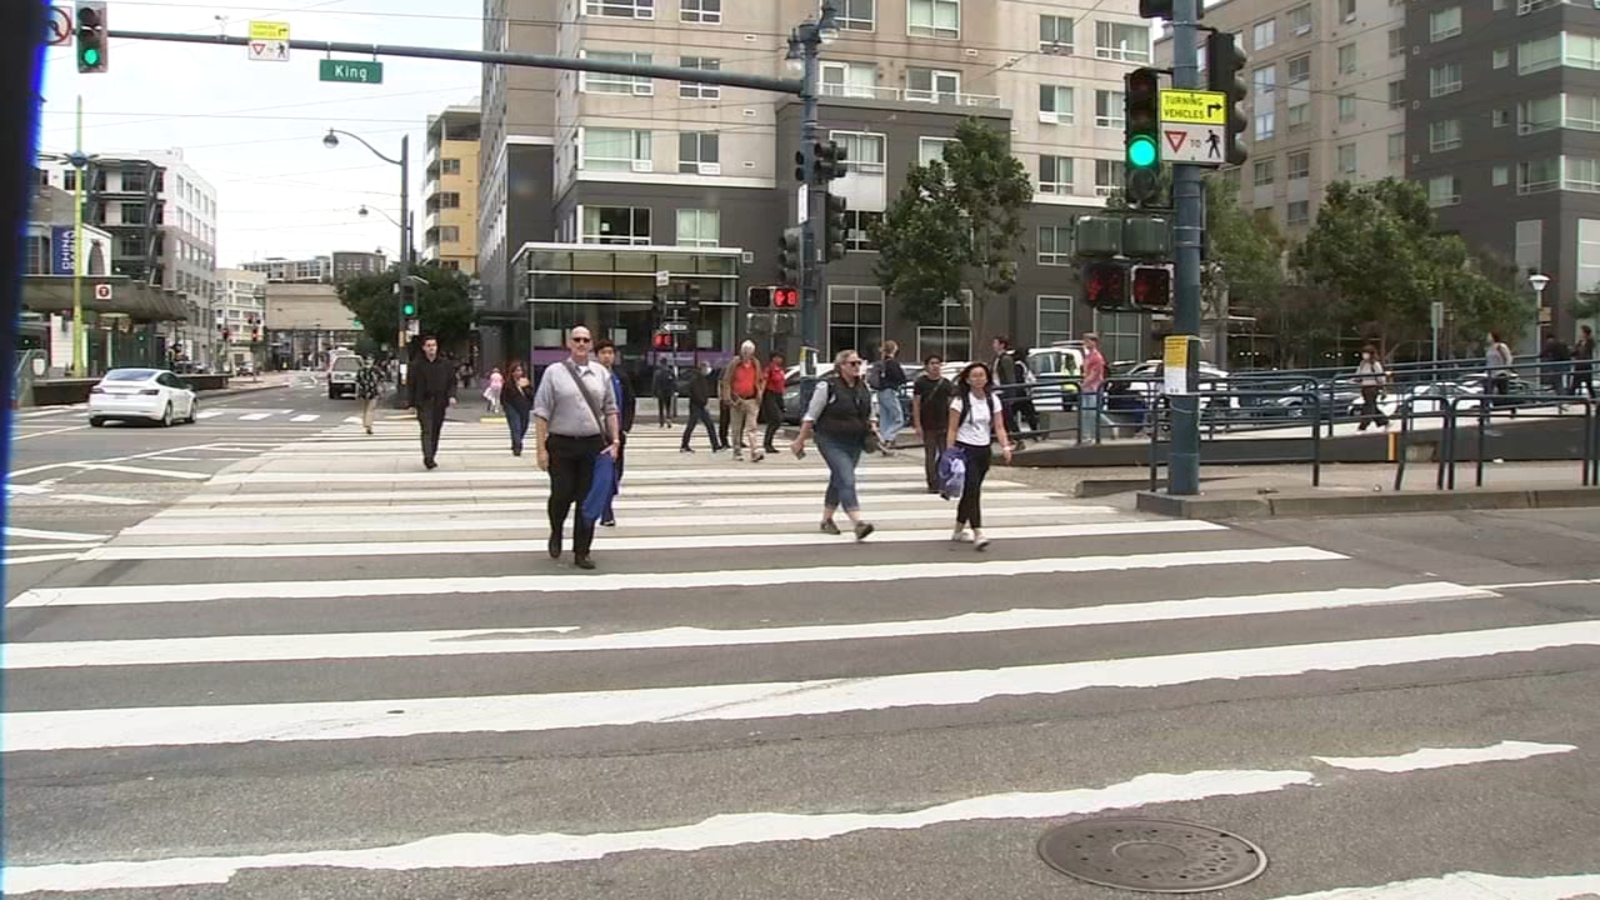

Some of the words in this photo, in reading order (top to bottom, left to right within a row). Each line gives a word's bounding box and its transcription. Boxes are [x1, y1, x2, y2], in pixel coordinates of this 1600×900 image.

[334, 64, 367, 82] King
[1164, 95, 1204, 106] TURNING
[1164, 109, 1205, 119] VEHICLES
[1190, 139, 1201, 148] TO
[61, 230, 71, 270] CHINA
